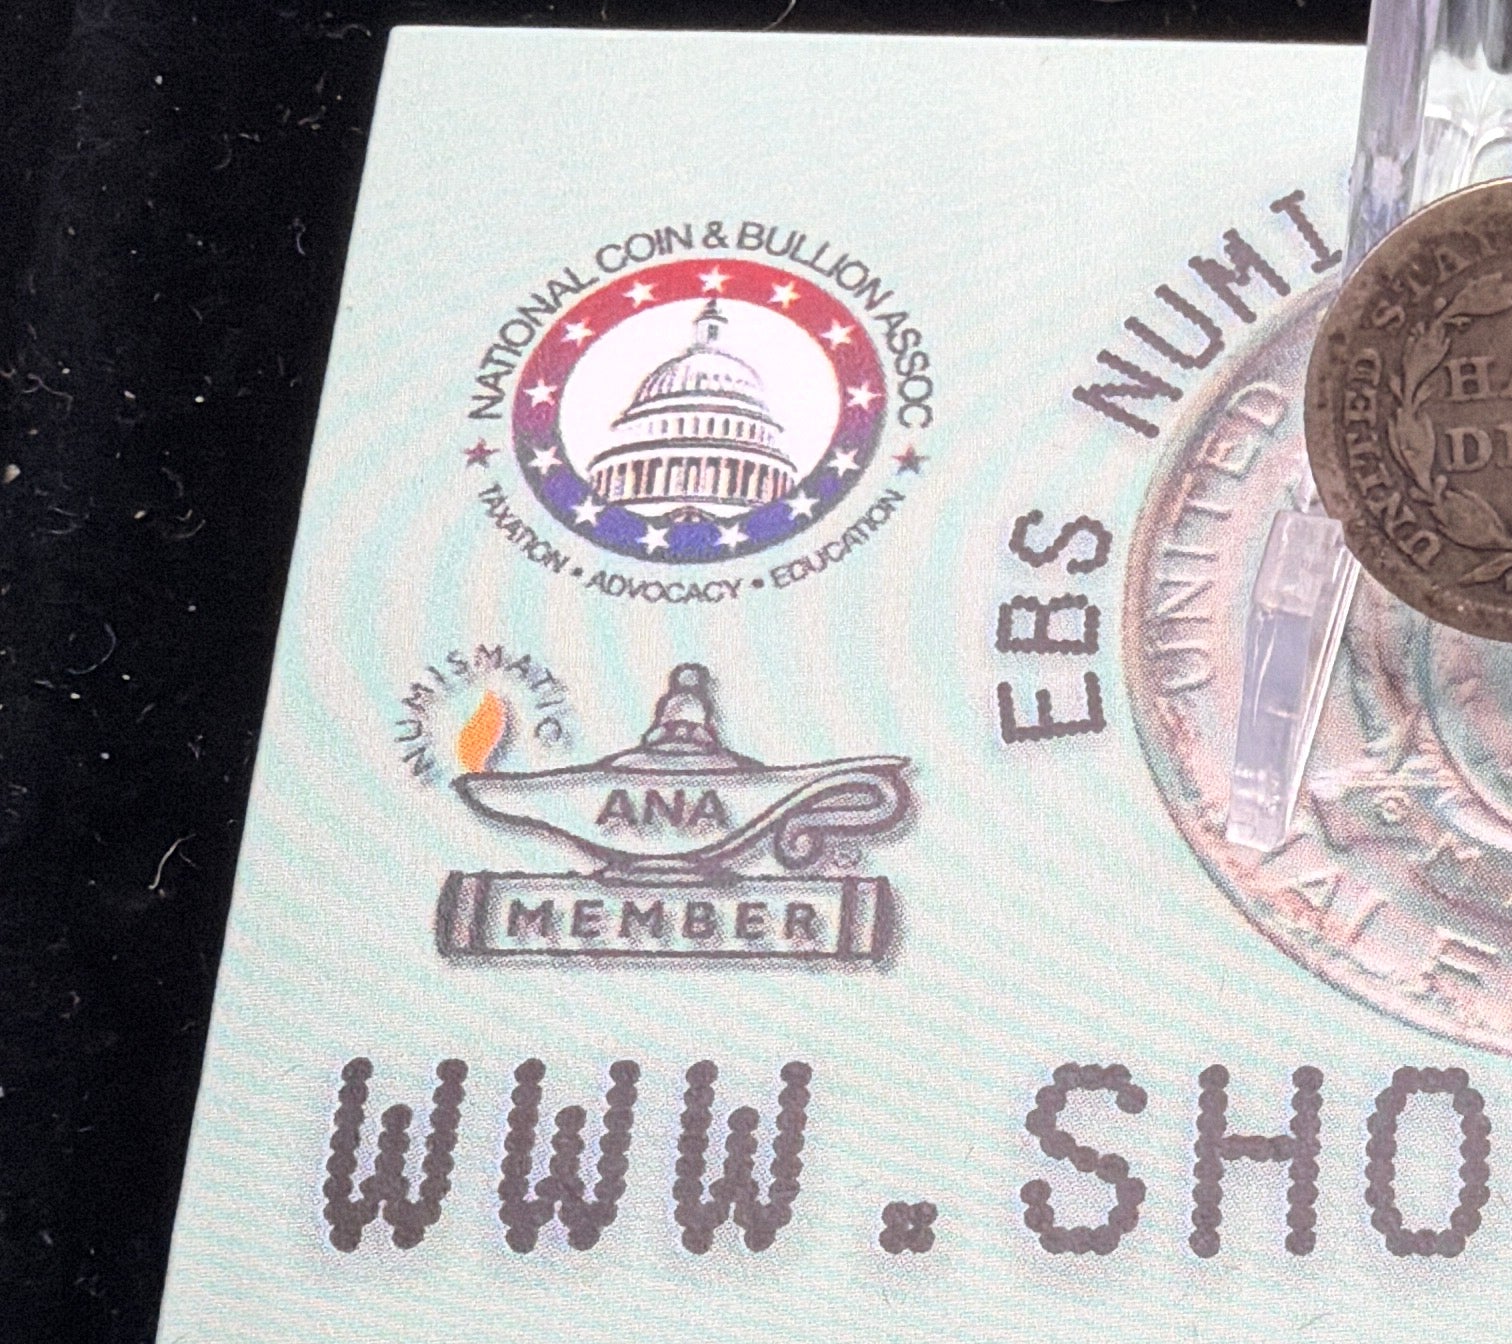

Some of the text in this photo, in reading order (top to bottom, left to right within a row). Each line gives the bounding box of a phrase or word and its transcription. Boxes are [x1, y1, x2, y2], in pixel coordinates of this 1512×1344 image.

[468, 221, 934, 430] NATIONAL COIN & BULLION ASSOC
[1152, 380, 1288, 698] UNITED
[1344, 347, 1442, 568] UNITED
[478, 484, 906, 605] TAXATION ADVOCACY EDUCATION
[996, 511, 1111, 743] EBS
[394, 643, 568, 776] NUMISMATIC
[596, 788, 730, 828] ANA
[506, 899, 820, 940] MEMBER
